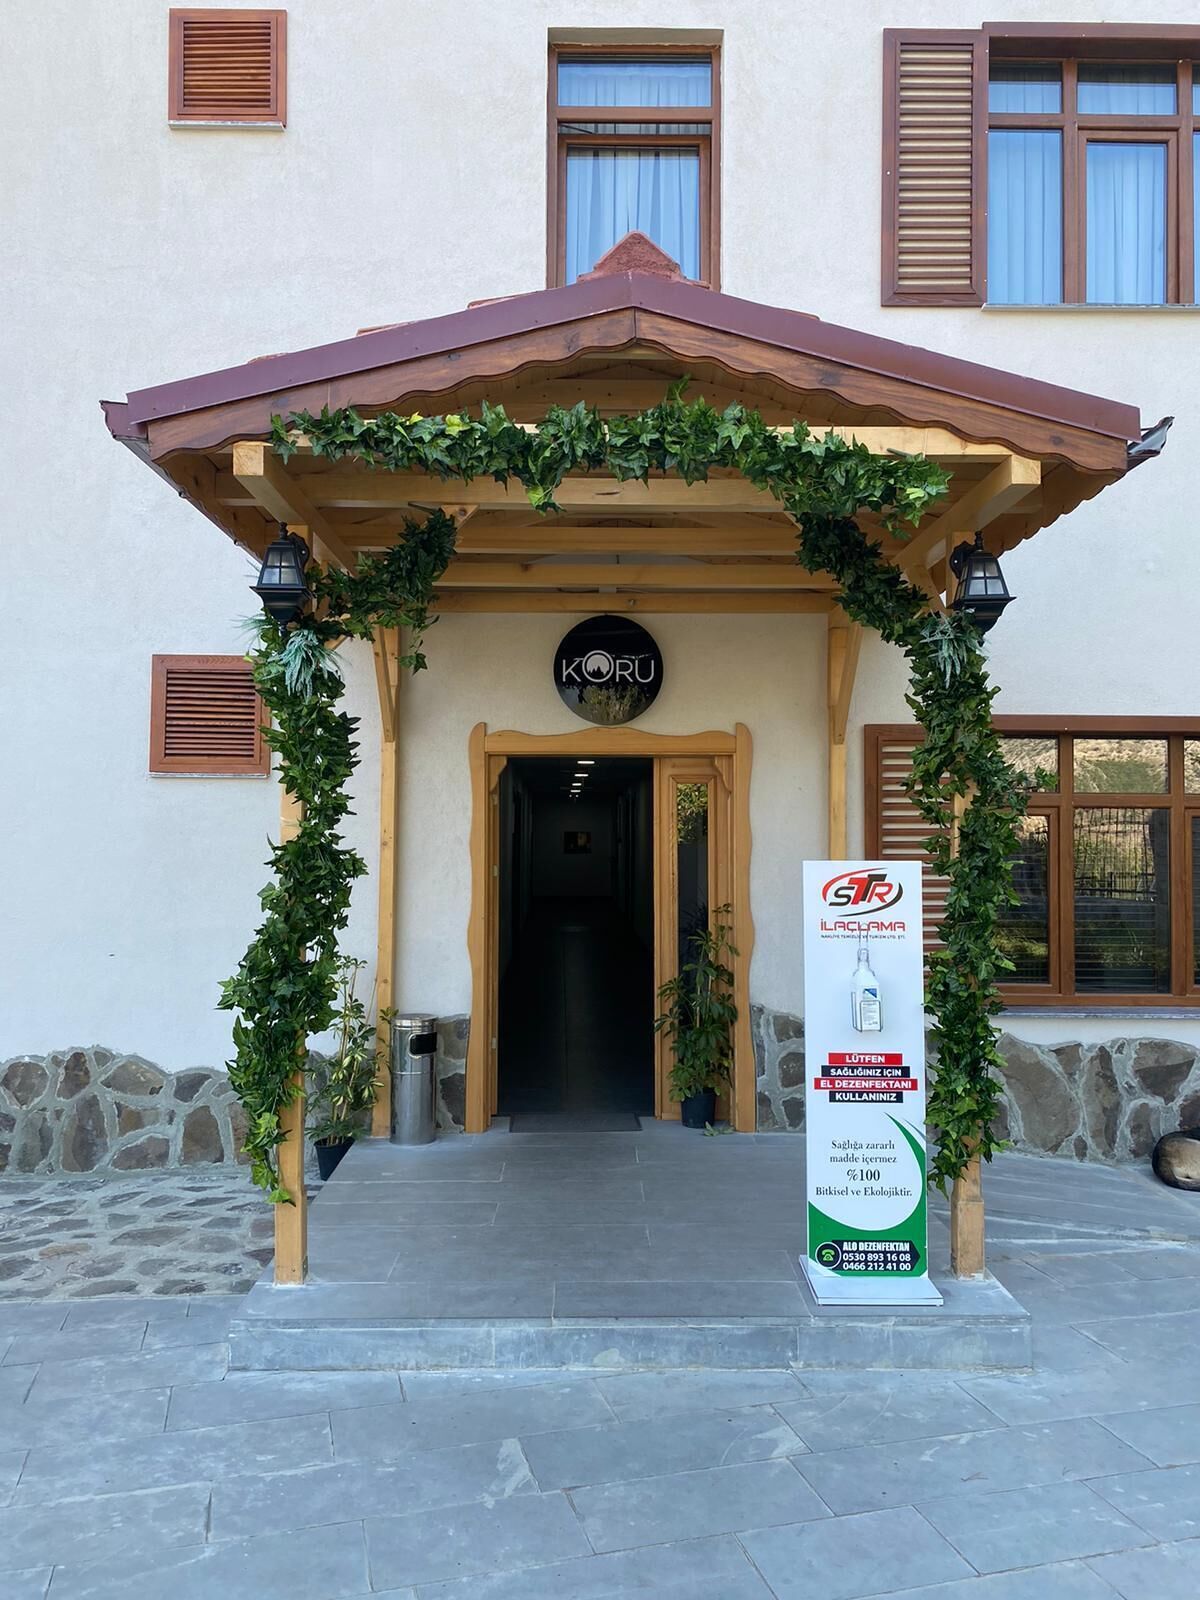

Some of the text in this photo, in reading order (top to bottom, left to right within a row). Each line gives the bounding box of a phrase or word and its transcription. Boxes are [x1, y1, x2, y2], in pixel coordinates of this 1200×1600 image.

[562, 650, 655, 682] KORU
[820, 918, 906, 933] İLAÇLAMA
[846, 1054, 885, 1063] LÜTFEN
[830, 1067, 881, 1076] SAĞLIĞINIZ
[820, 1080, 912, 1088] EL DEZENFEKTANI
[836, 1093, 897, 1101] KULLANINIZ
[831, 1140, 895, 1150] Sağlığa zararlı
[830, 1153, 897, 1165] madde içermez
[846, 1169, 880, 1181] %100
[816, 1186, 848, 1196] Bitkisel
[864, 1187, 912, 1198] Ekolojiktir.
[842, 1242, 910, 1251] ALO DEZENFEKTAN
